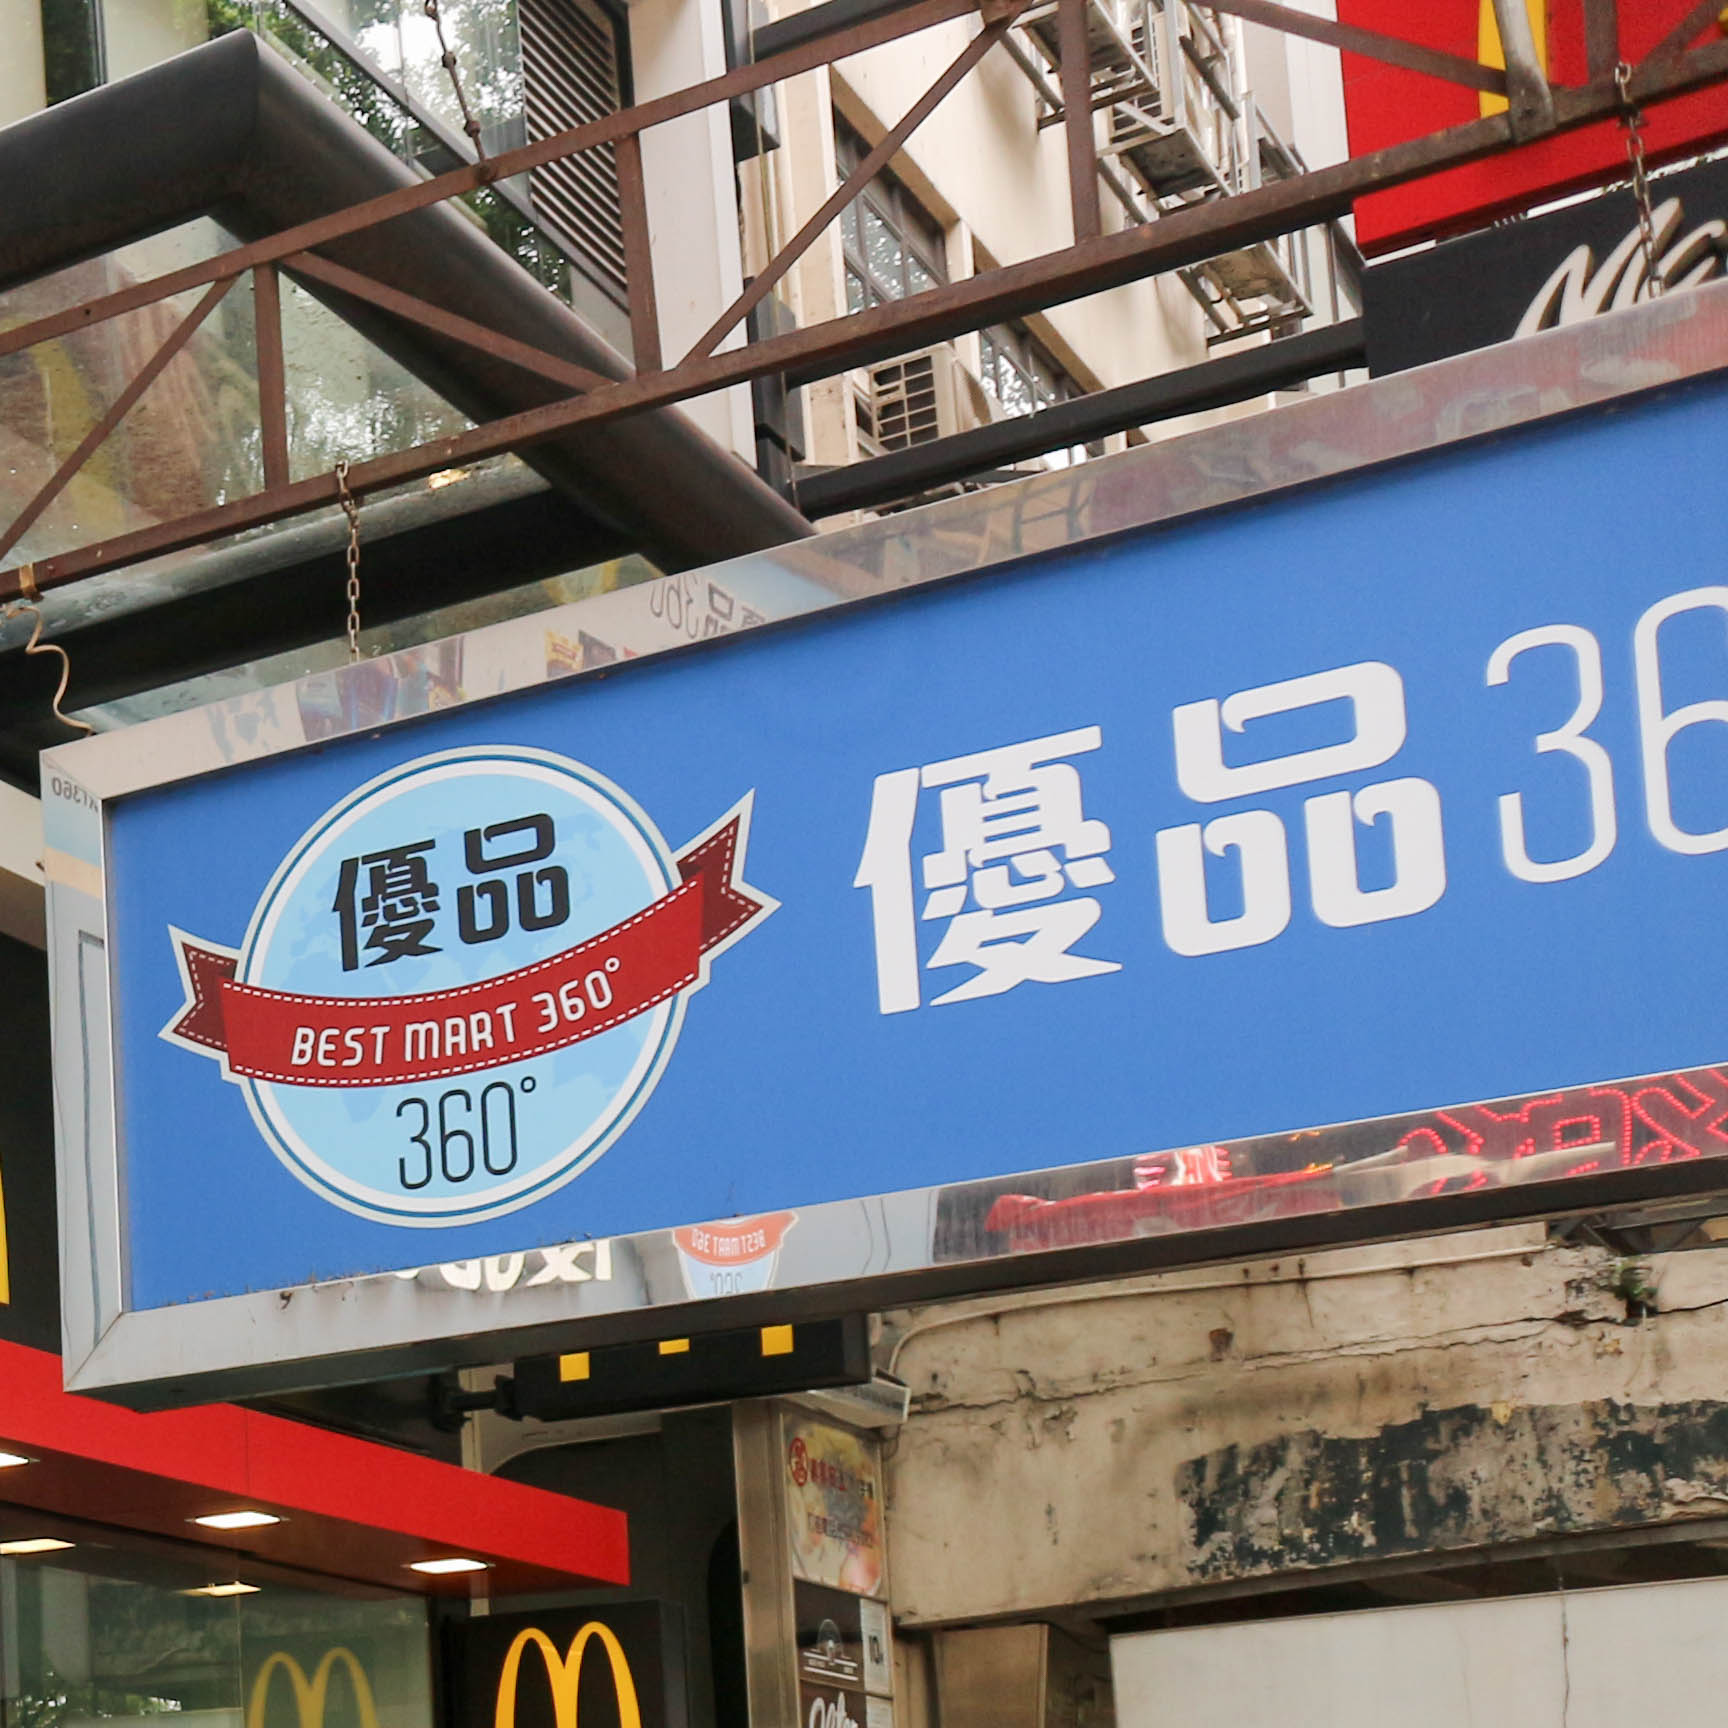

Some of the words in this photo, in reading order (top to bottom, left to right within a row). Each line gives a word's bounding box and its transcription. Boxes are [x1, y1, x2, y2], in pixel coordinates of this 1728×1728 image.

[332, 811, 572, 972] 優品
[290, 1023, 388, 1068] BEST
[403, 1011, 518, 1061] MART
